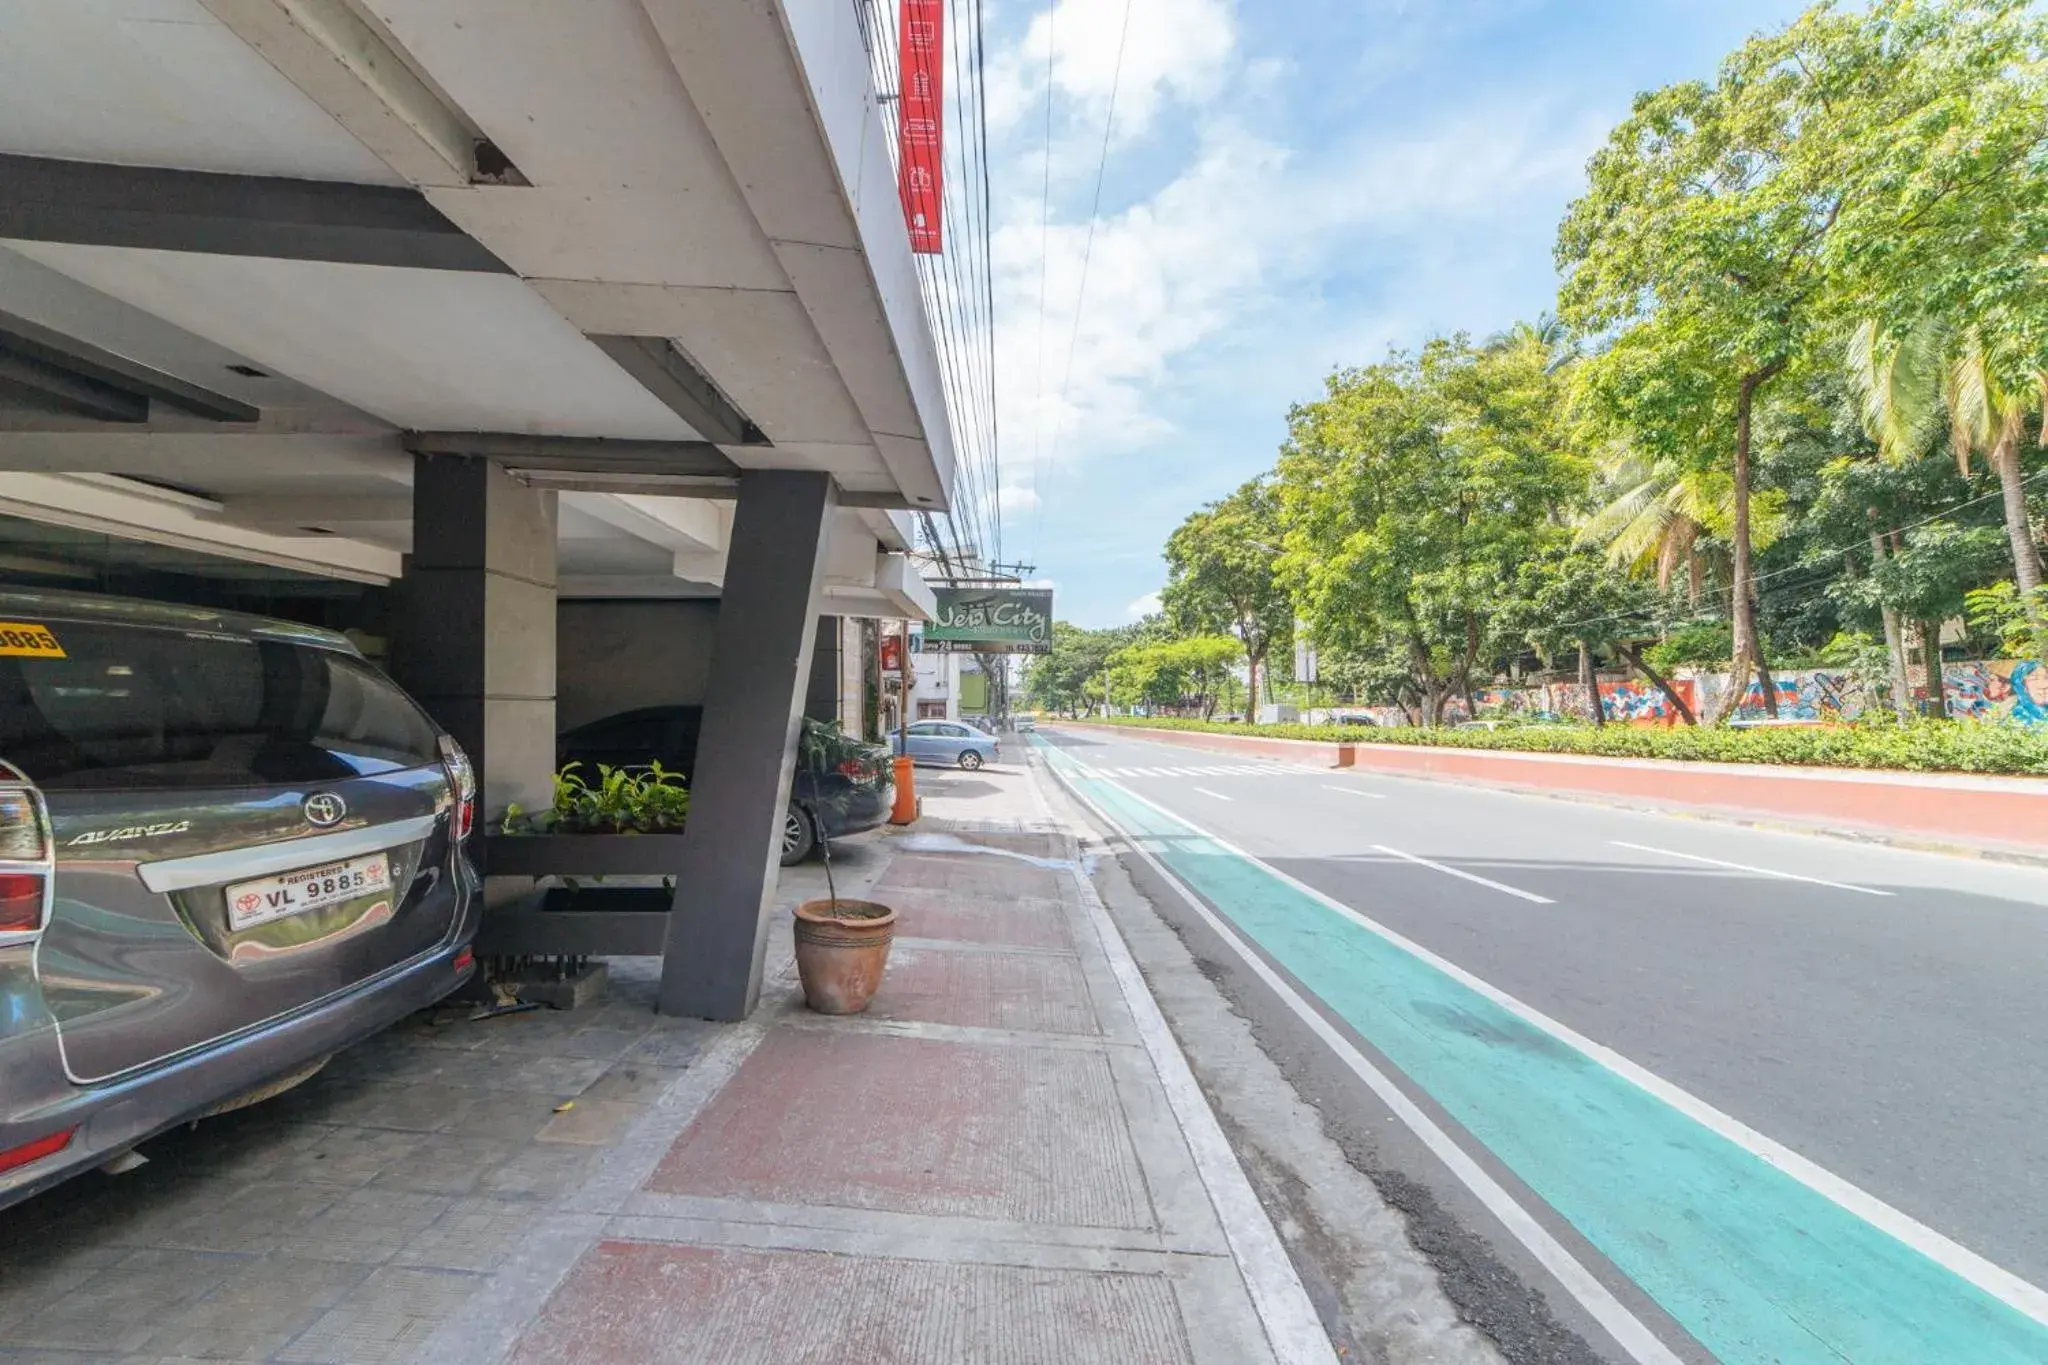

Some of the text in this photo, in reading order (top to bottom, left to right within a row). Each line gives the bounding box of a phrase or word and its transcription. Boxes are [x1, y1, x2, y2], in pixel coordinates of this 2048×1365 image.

[932, 600, 1046, 643] New City
[67, 821, 190, 846] AVANZA
[266, 889, 295, 907] VL
[307, 872, 364, 898] 9885
[287, 866, 344, 885] REGISTERED
